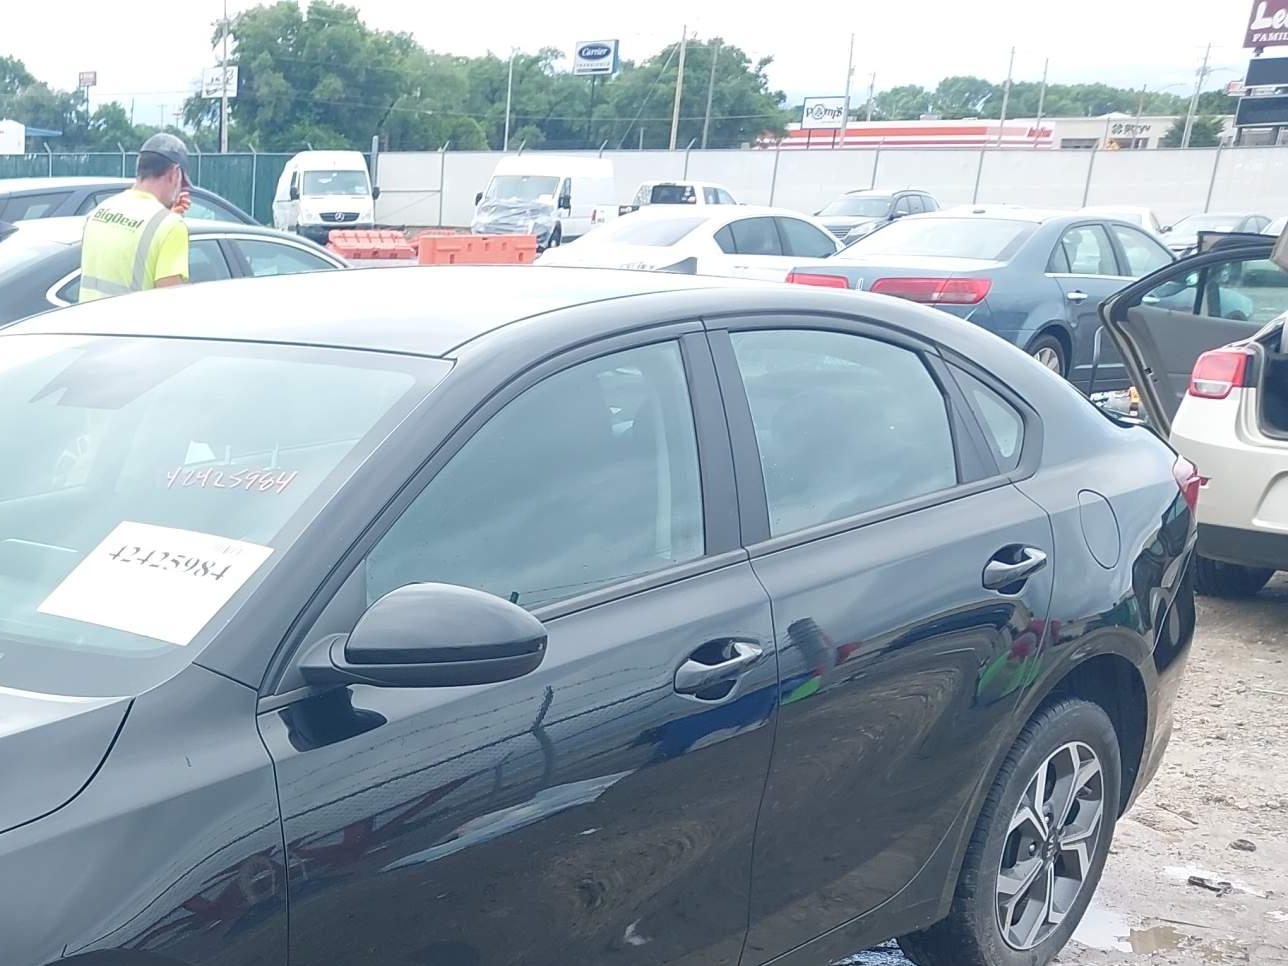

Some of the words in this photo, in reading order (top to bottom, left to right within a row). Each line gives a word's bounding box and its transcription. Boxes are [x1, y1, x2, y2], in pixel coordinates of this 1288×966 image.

[1250, 1, 1288, 30] Le
[581, 47, 608, 57] Carrier
[94, 208, 144, 229] BigDeal
[167, 466, 299, 494] 42425984
[109, 545, 232, 581] 42425984
